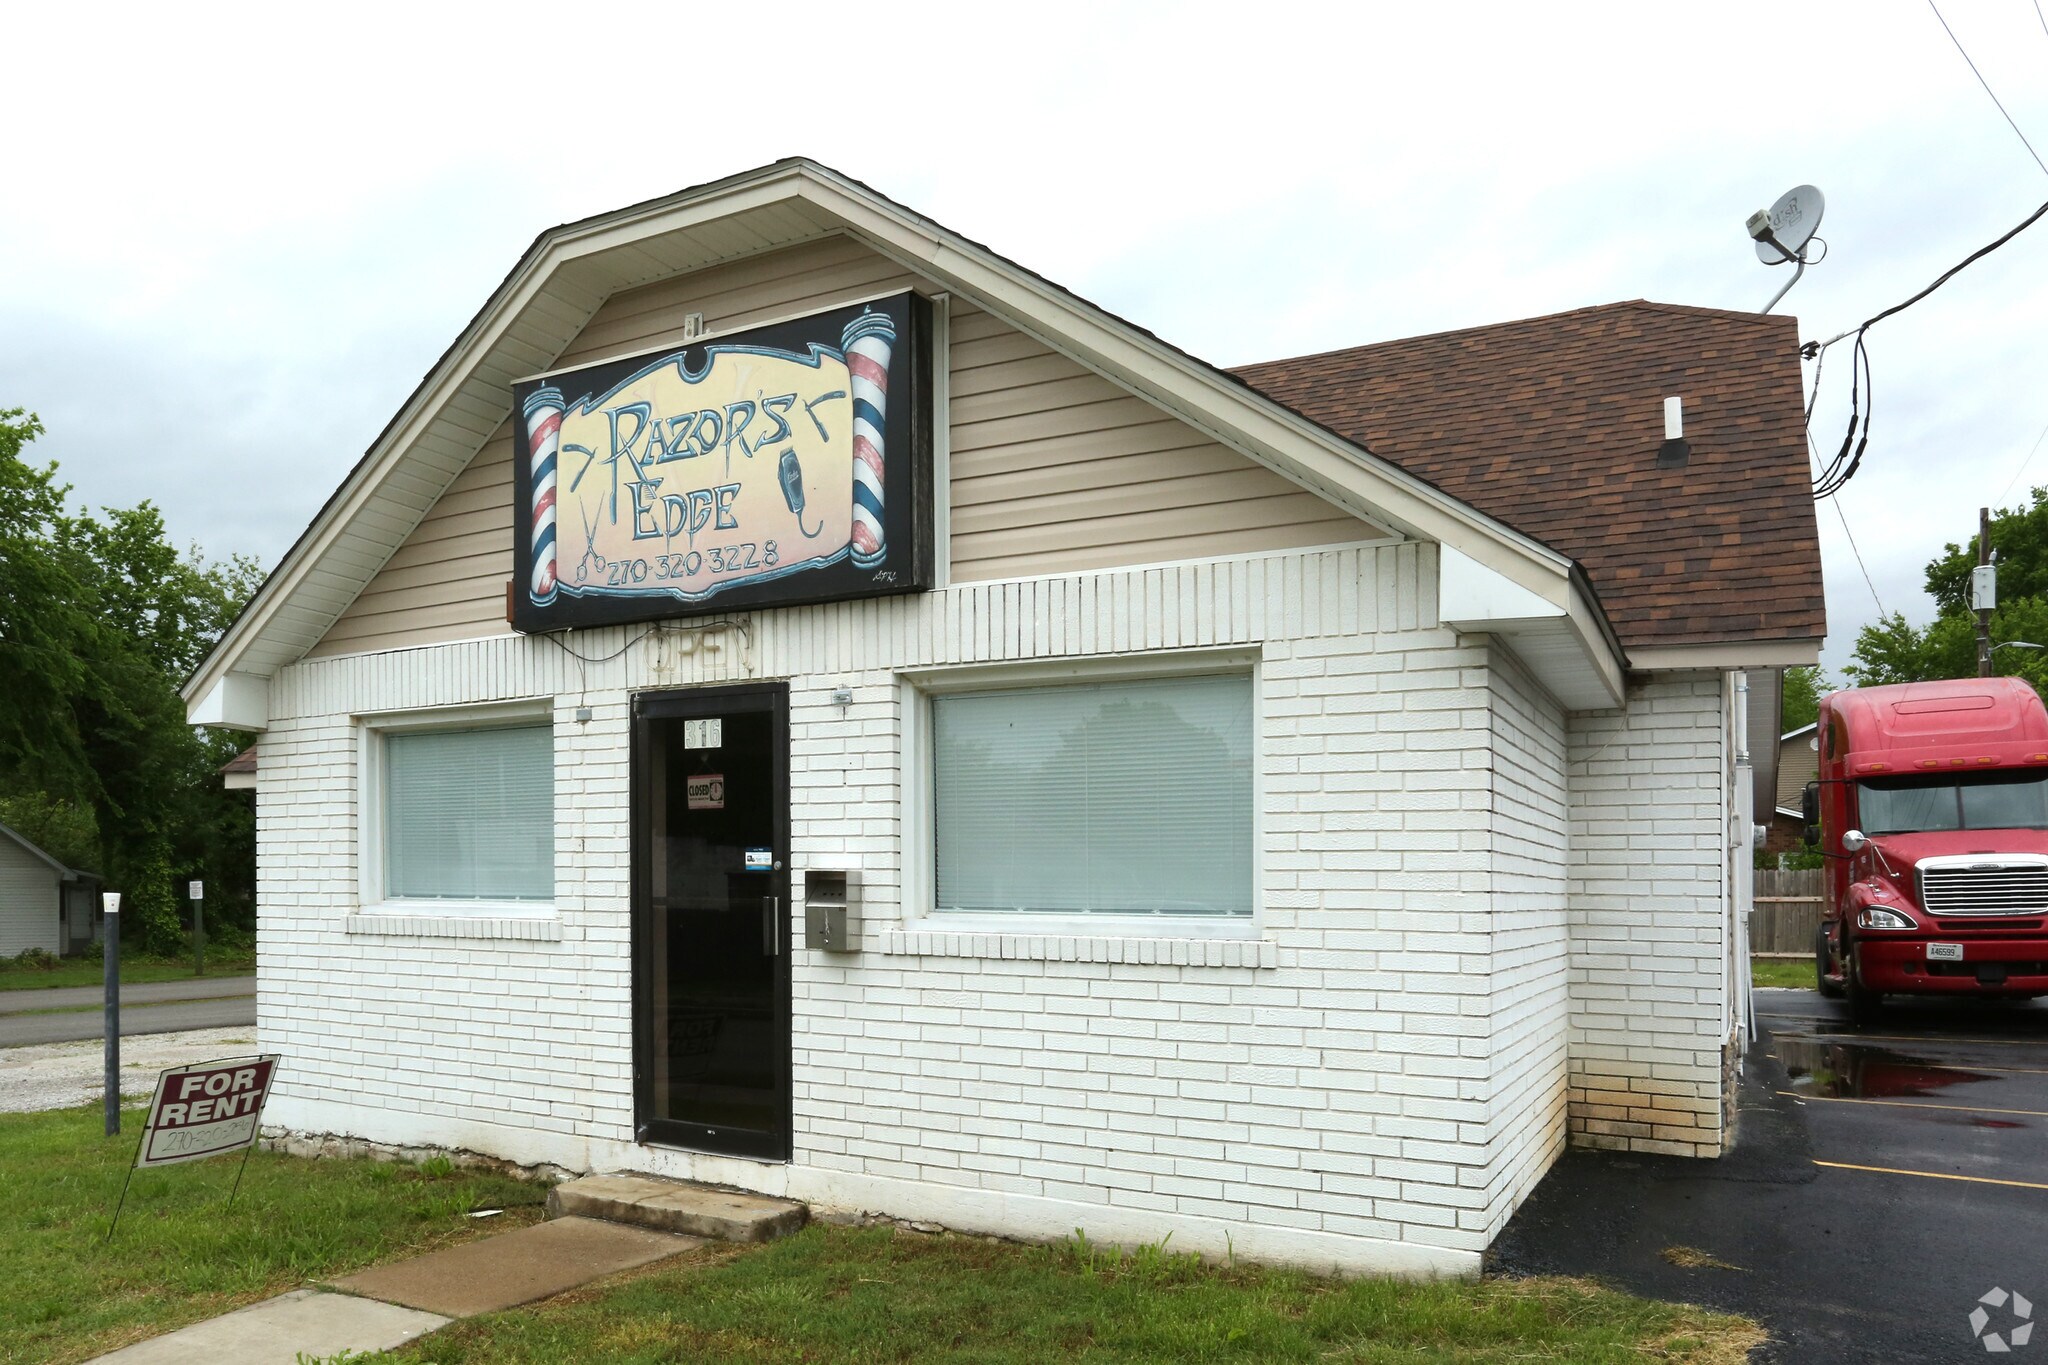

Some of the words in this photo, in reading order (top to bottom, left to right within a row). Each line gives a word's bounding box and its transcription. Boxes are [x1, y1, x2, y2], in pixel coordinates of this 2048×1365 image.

[598, 389, 798, 525] RAZOR'S
[624, 477, 742, 554] EDGE
[686, 720, 720, 747] 316
[688, 784, 710, 797] CLOSED
[179, 1068, 257, 1100] FOR
[158, 1089, 262, 1127] RENT
